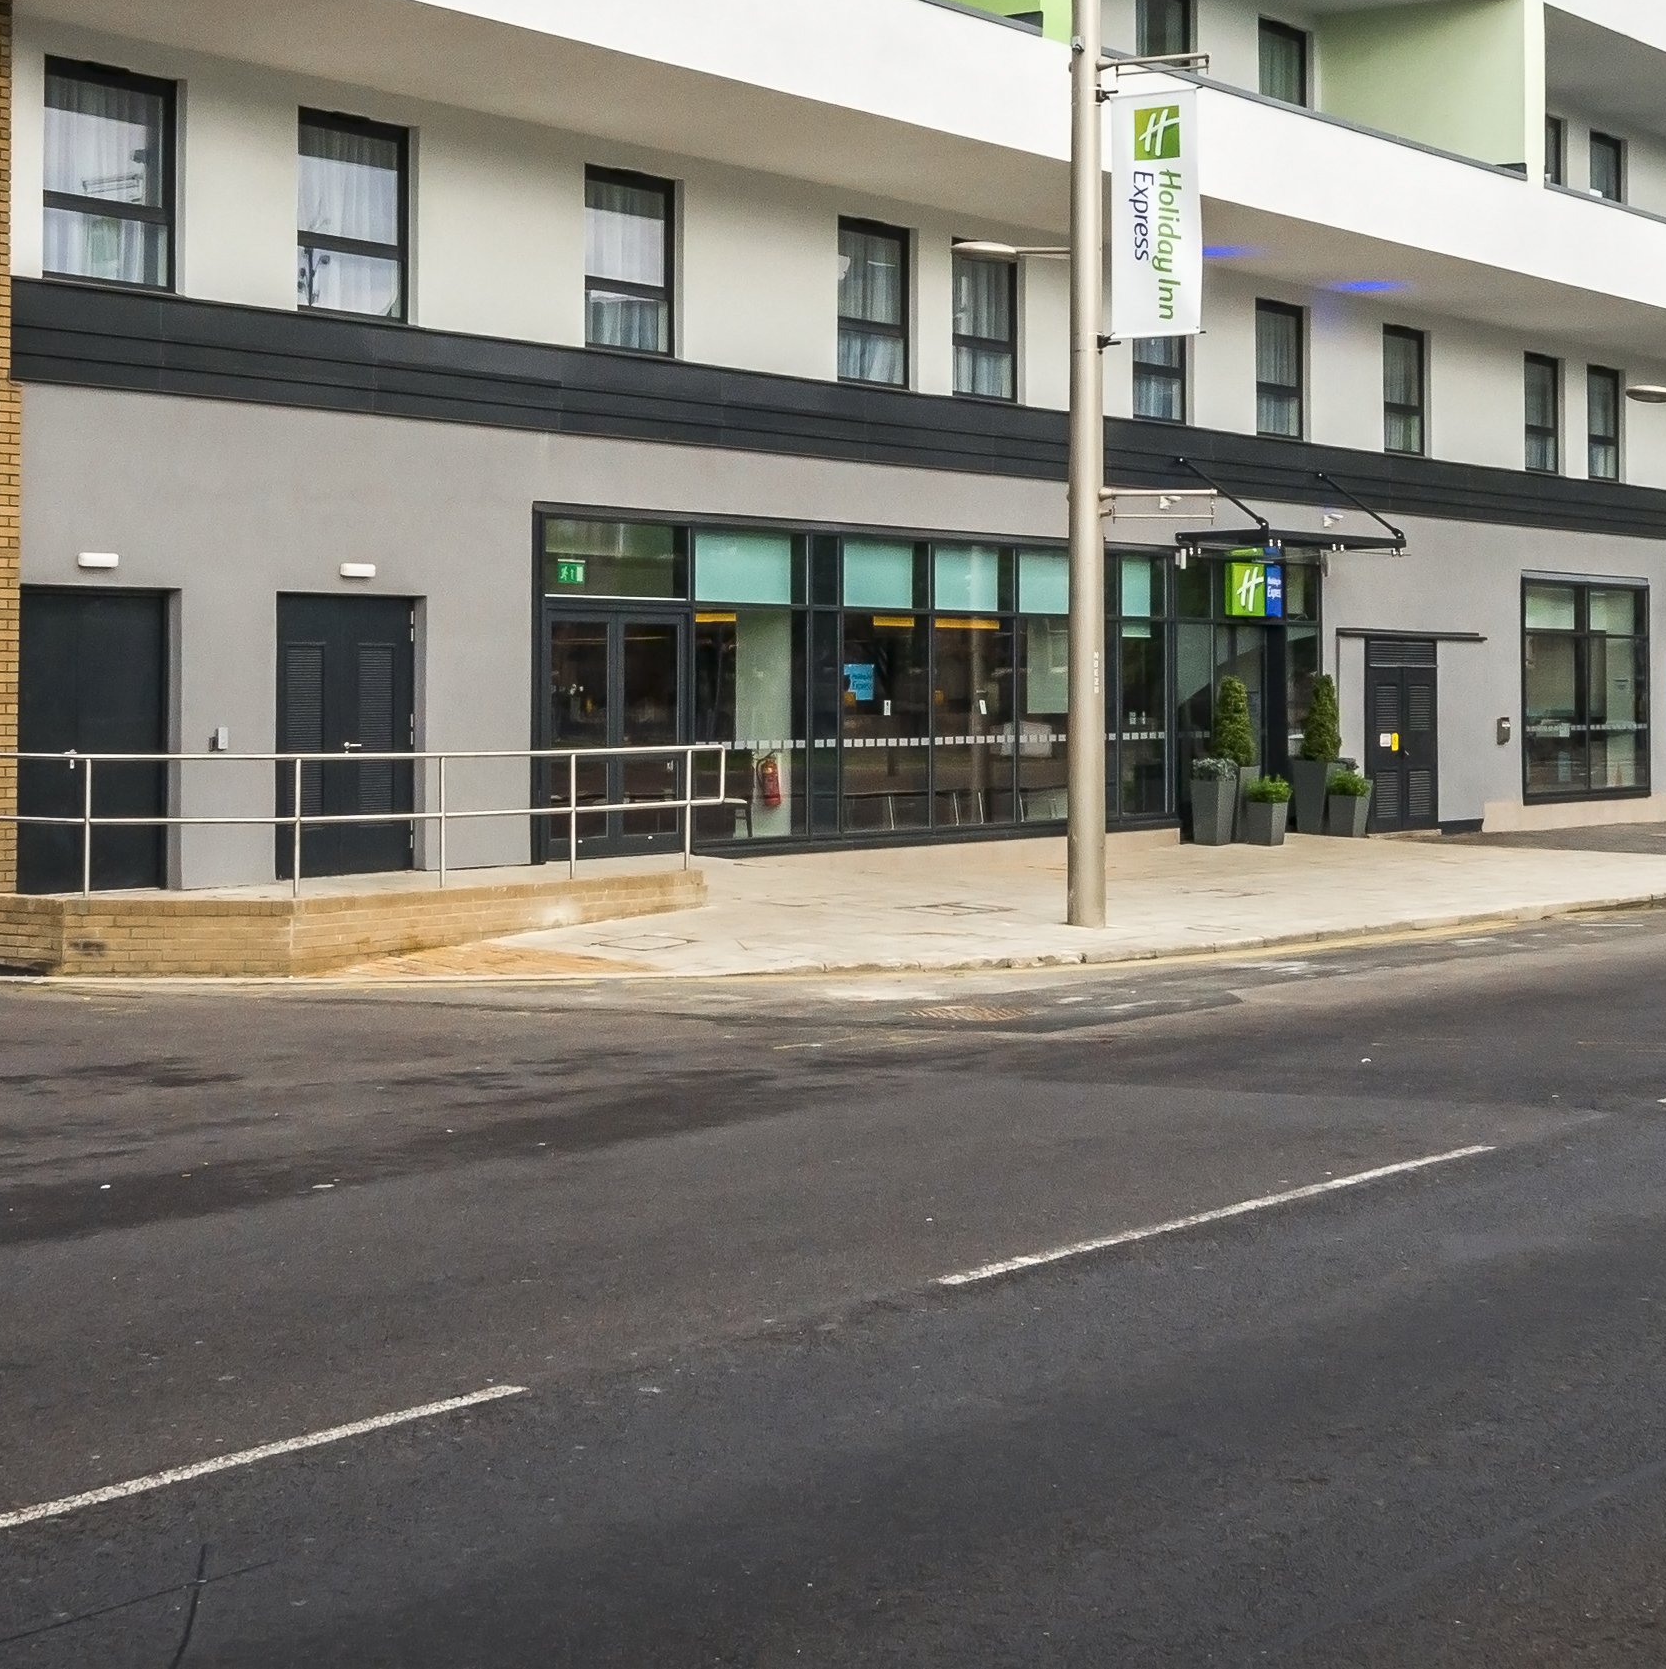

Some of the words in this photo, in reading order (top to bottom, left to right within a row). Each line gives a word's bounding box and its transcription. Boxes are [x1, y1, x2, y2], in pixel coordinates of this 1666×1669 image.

[1128, 170, 1154, 261] Express
[1151, 168, 1182, 273] Holiday
[1158, 278, 1181, 321] Inn
